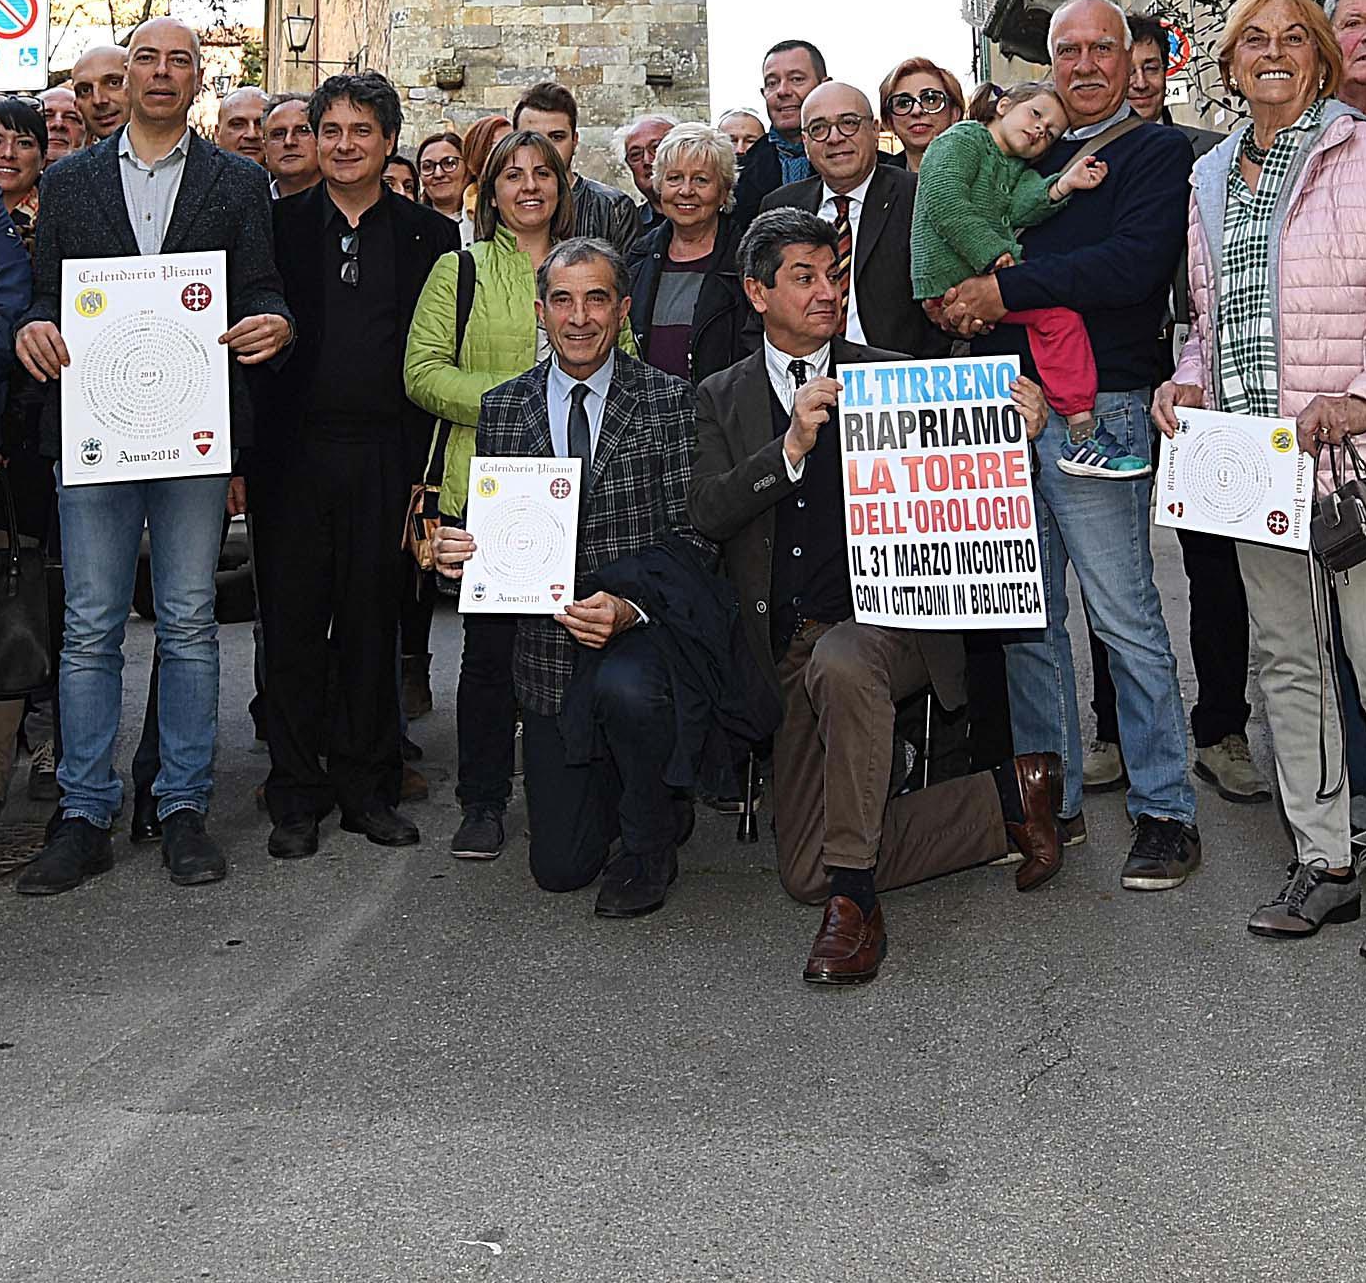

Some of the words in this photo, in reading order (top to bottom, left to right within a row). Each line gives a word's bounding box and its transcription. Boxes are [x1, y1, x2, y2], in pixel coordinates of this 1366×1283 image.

[78, 267, 156, 284] Calendario
[160, 265, 213, 283] Pisano
[140, 371, 157, 379] 2018
[843, 370, 873, 406] IL
[874, 362, 1016, 404] TIRRENO
[844, 404, 1022, 452] RIAPRIAMO
[479, 462, 534, 474] Calendario
[536, 463, 573, 476] Pisano
[848, 458, 896, 495] LA
[901, 450, 1027, 493] TORRE
[849, 495, 1031, 535] DELL'OROLOGIO
[1293, 496, 1306, 539] Pisano
[851, 545, 867, 576] IL
[870, 544, 889, 577] 31
[894, 541, 951, 576] MARZO
[954, 538, 1037, 575] INCONTRO
[855, 584, 881, 613] CON
[884, 586, 889, 614] I
[892, 585, 951, 616] CITTADINI
[953, 585, 966, 615] IN
[970, 582, 1042, 616] BIBLIOTECA
